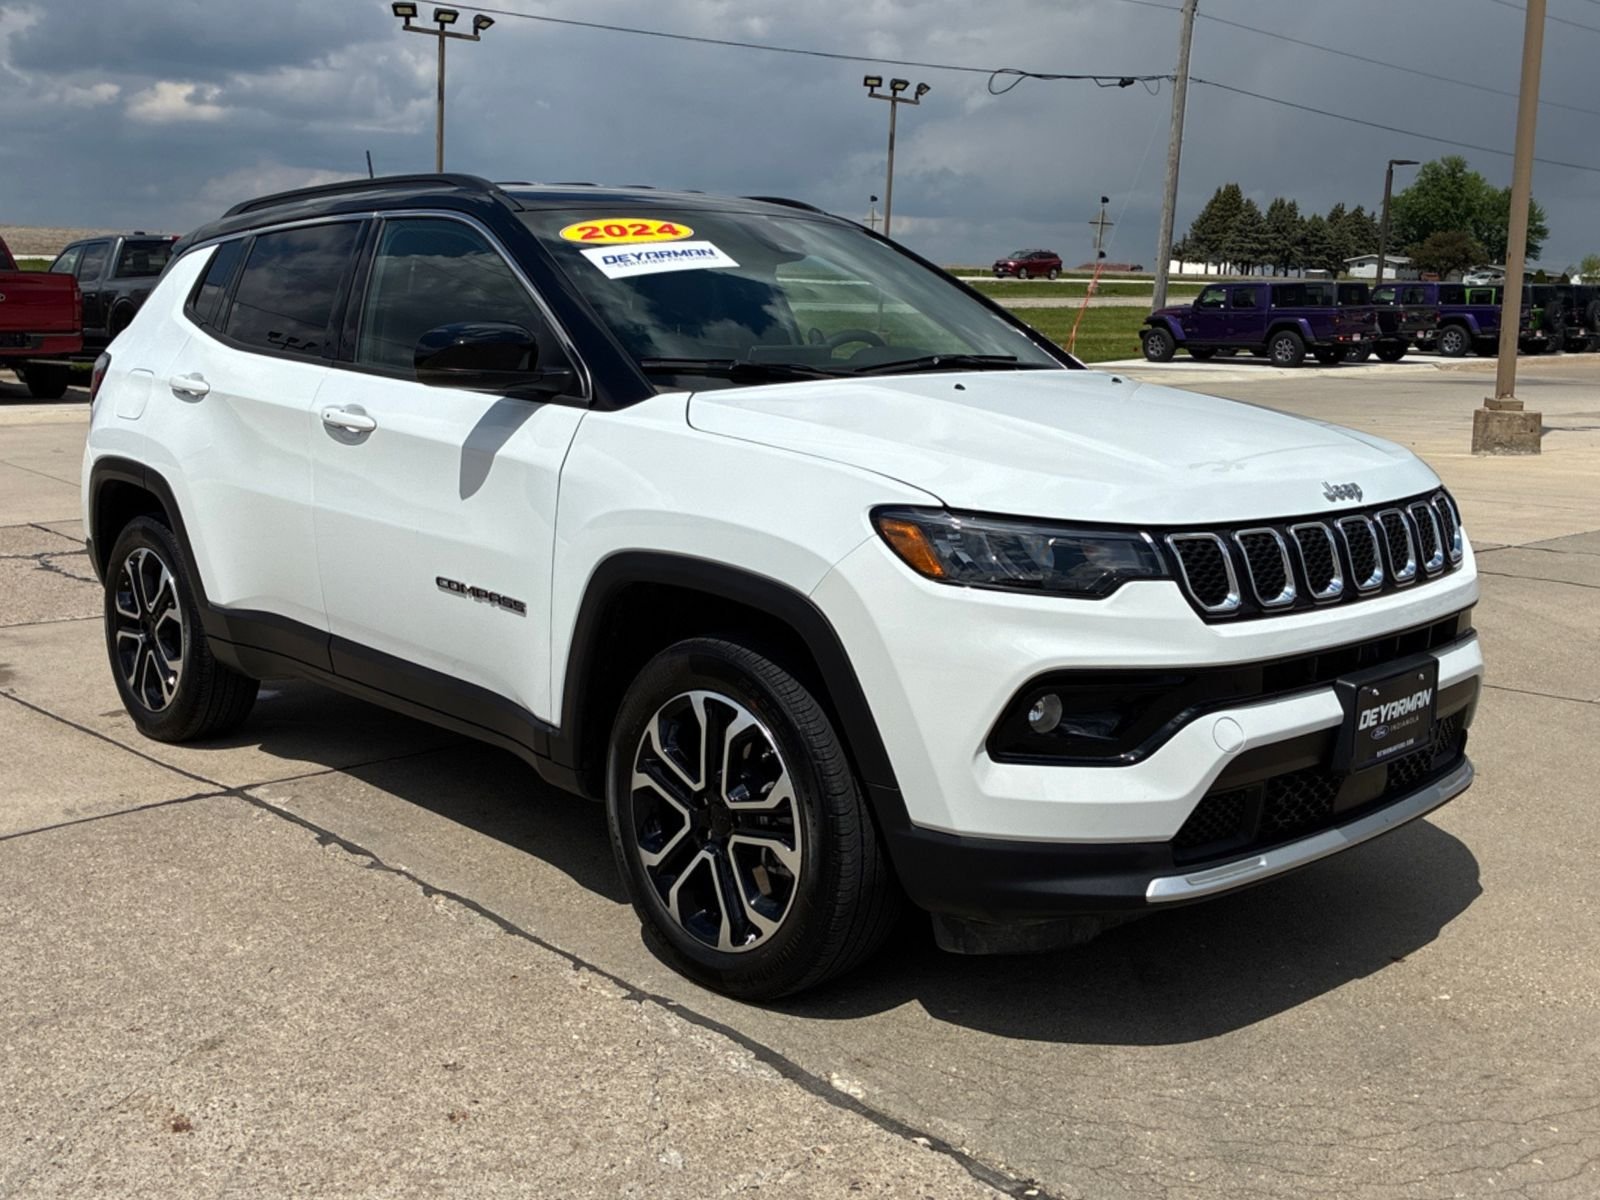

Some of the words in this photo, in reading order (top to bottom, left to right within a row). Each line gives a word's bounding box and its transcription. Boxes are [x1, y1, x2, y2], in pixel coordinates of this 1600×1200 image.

[577, 223, 681, 240] 2024
[602, 248, 716, 266] DEYARMAN
[1320, 481, 1363, 503] Jeep
[435, 576, 527, 615] COMPASS
[1358, 688, 1433, 731] DEYARMAN
